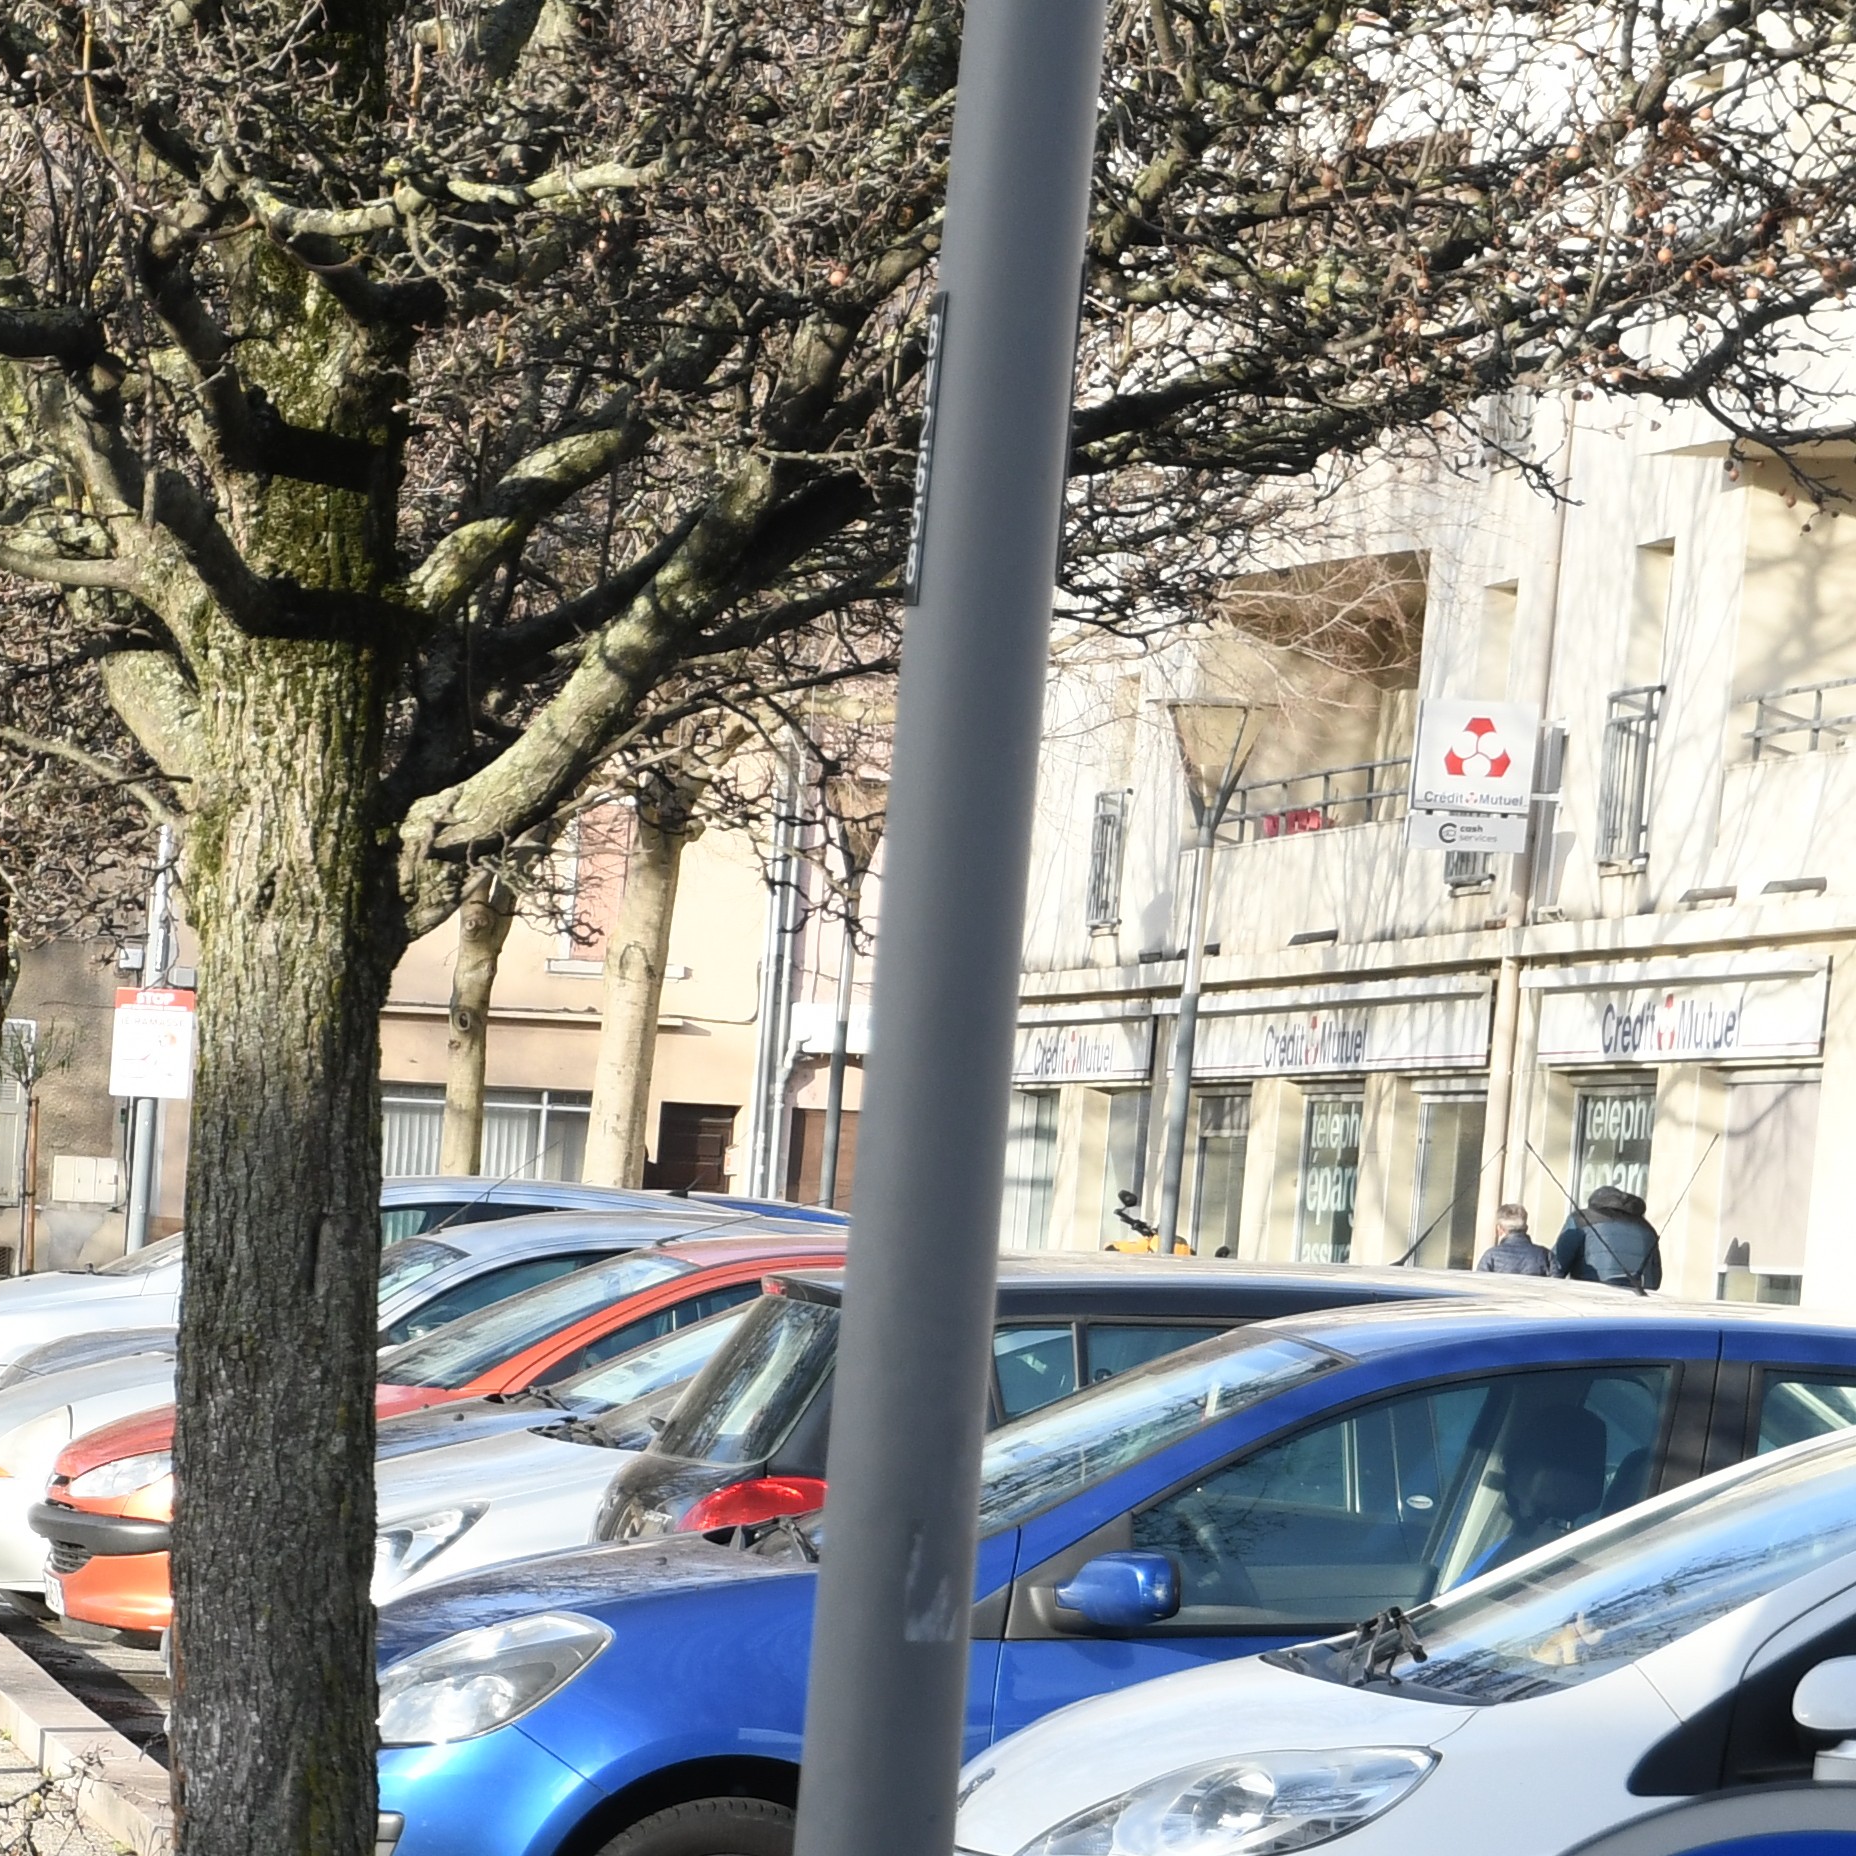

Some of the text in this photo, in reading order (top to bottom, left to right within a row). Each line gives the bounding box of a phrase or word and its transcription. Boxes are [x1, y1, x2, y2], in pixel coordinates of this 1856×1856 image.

[1423, 790, 1524, 807] Crédit Mutuel
[1459, 824, 1484, 834] cash
[1459, 833, 1498, 844] services
[136, 991, 175, 1005] STOP
[1600, 998, 1744, 1055] Crédit Mutuel
[1262, 1018, 1369, 1069] Crédit Mutuel
[1031, 1032, 1115, 1076] Crédit Mutuel
